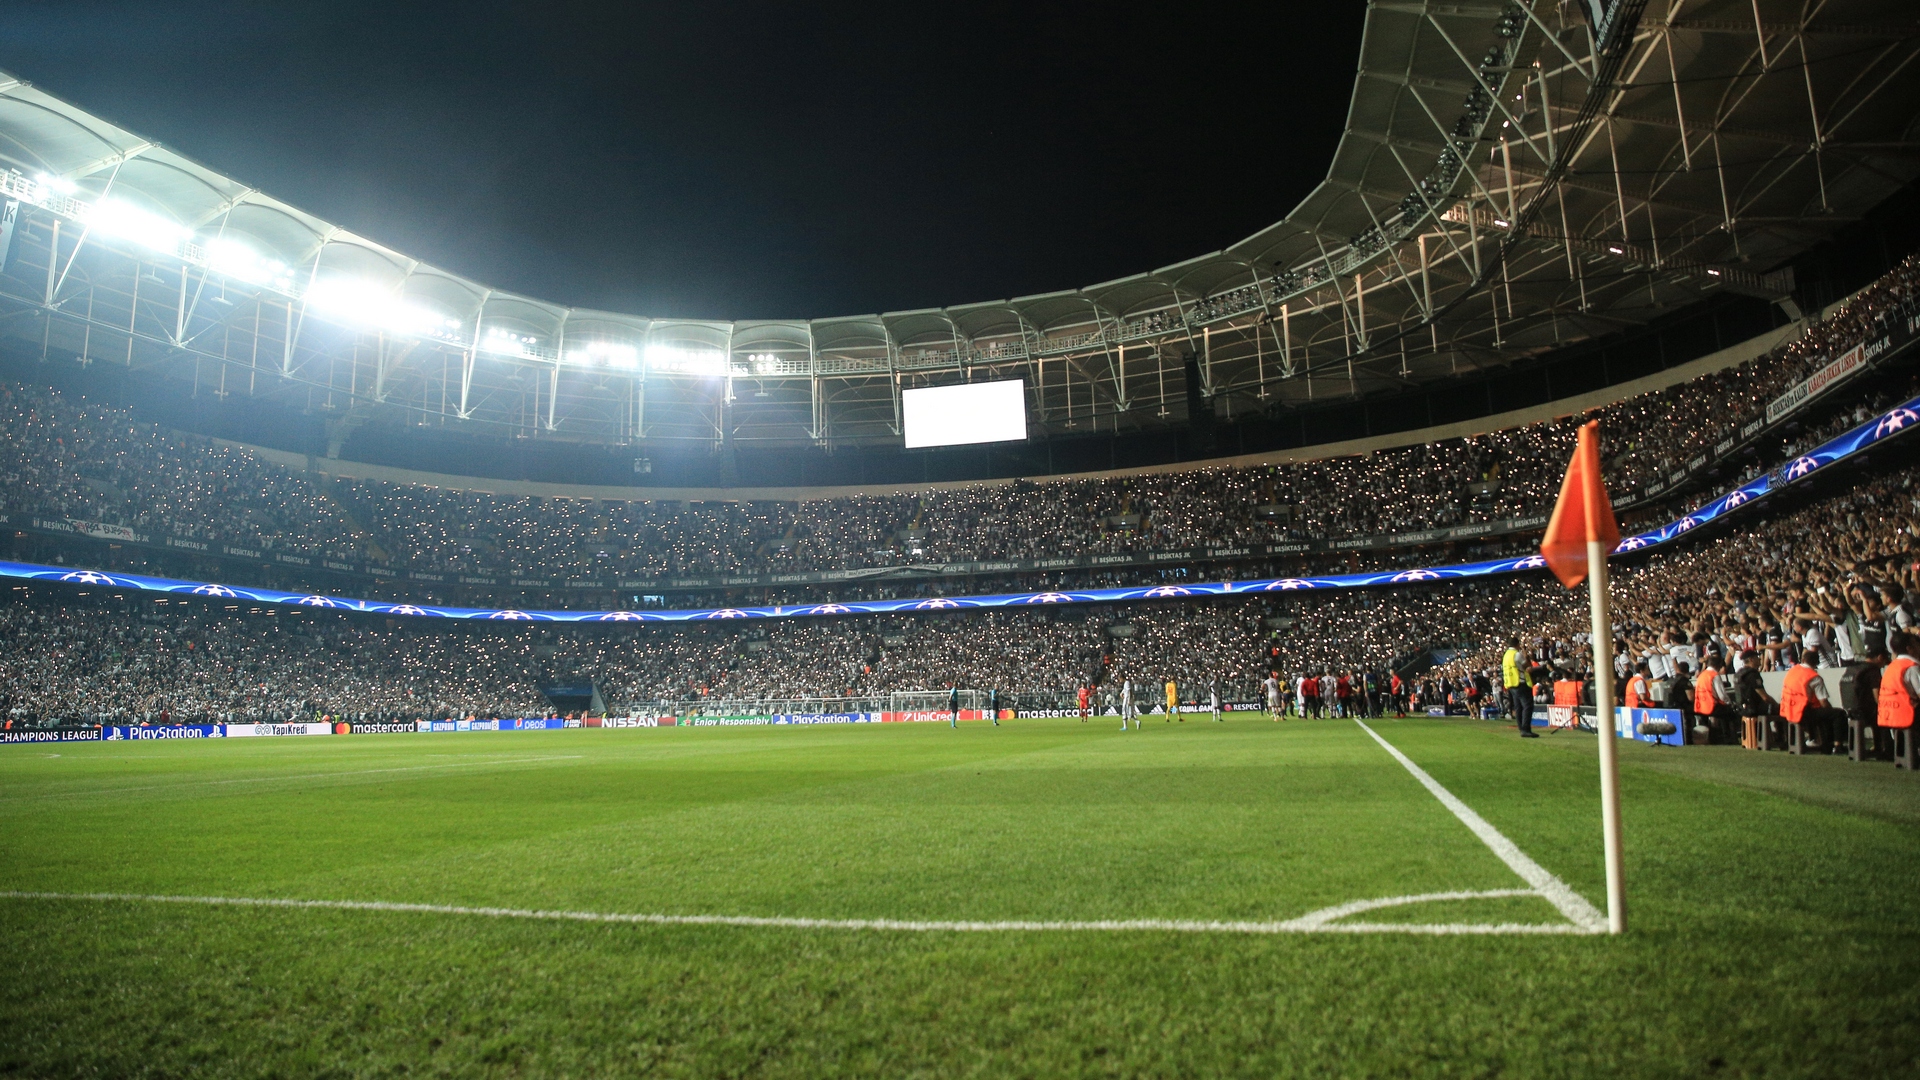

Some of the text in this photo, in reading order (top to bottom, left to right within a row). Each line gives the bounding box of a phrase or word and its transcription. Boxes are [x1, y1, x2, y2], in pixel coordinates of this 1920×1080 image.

[913, 711, 960, 721] UniCredt
[1018, 706, 1094, 719] mastercad
[1549, 707, 1571, 727] NISSAN
[601, 717, 659, 728] NISSAN
[694, 716, 770, 726] Enjoy Responsibly
[792, 714, 851, 724] PlayStation
[353, 722, 414, 734] mastercard
[433, 722, 455, 731] GAZPROM
[471, 722, 492, 731] GAZPROM
[524, 720, 547, 730] pepsi
[0, 730, 99, 742] CHAMPIONS LEAGUE
[130, 726, 203, 740] PlayStation
